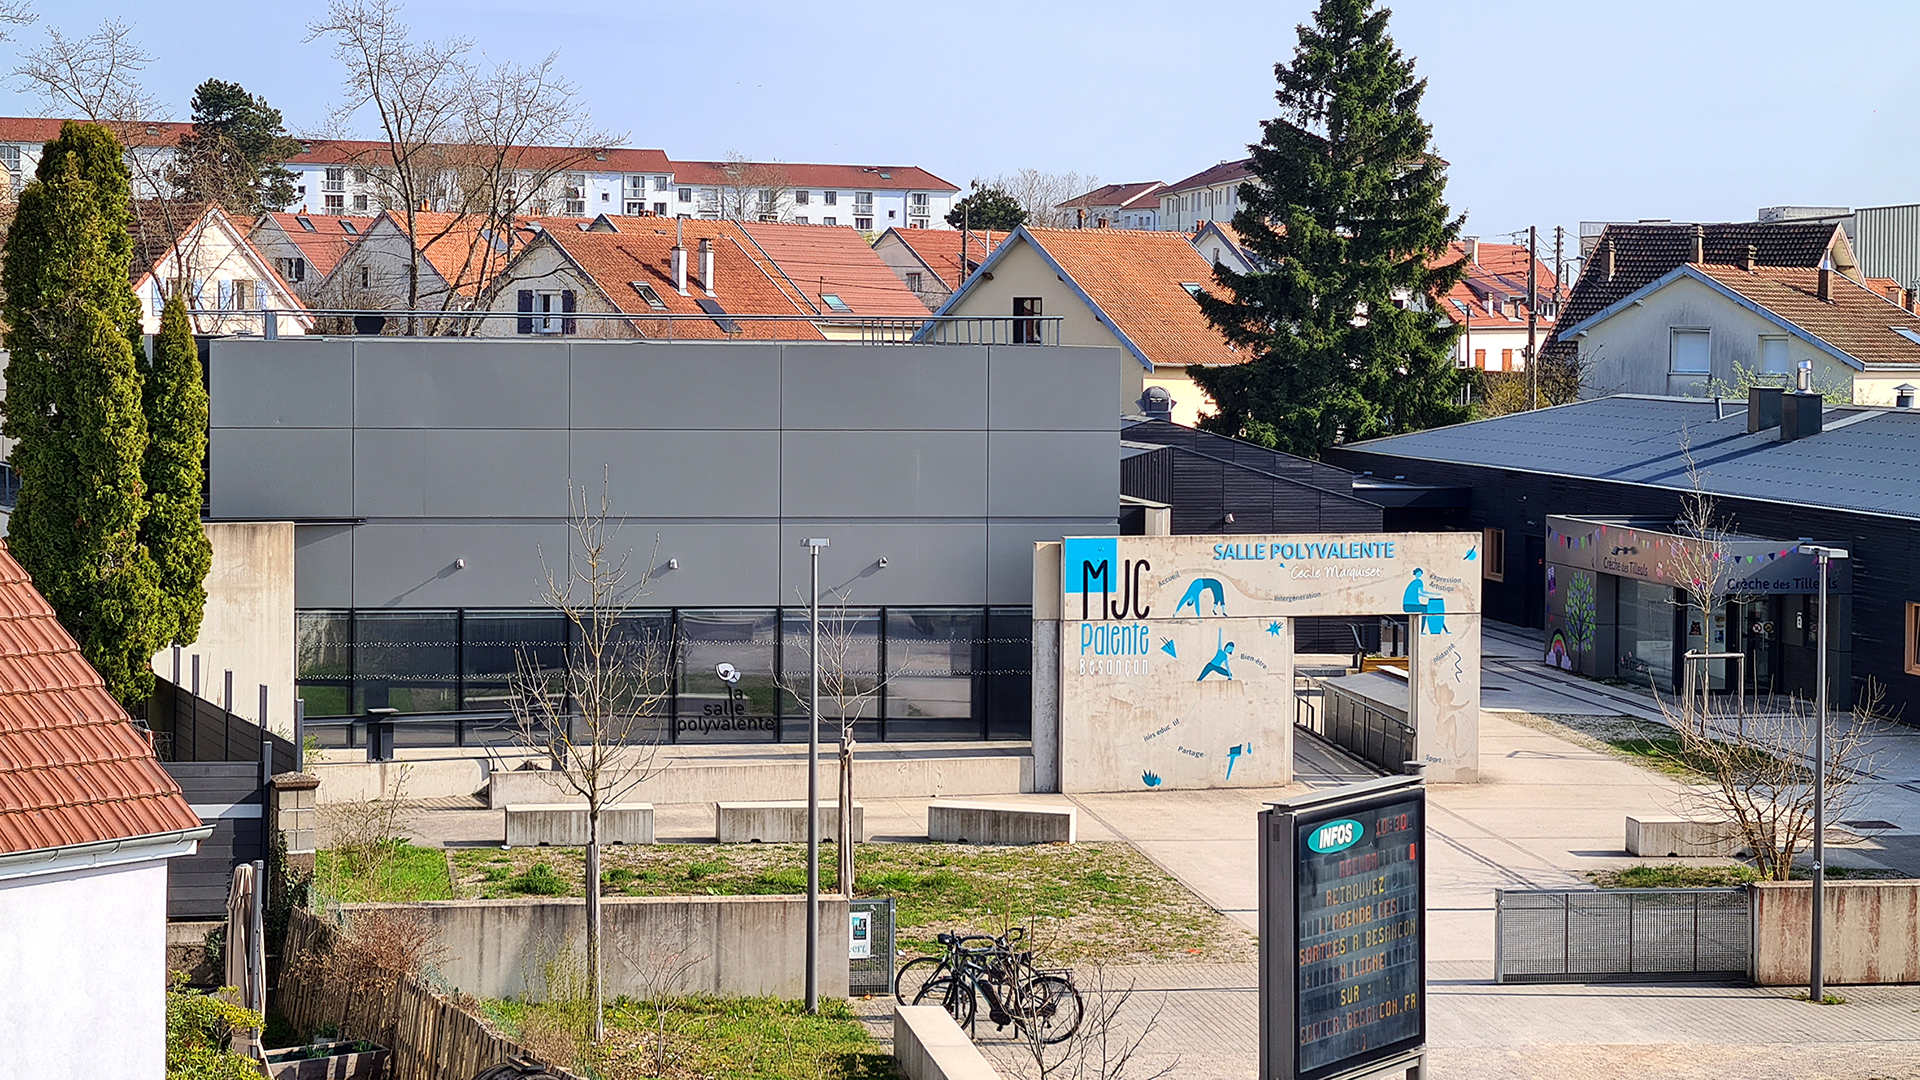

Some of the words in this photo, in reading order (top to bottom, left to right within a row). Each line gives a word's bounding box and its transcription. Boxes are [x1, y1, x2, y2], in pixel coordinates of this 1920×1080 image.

[1213, 542, 1266, 560] SALLE
[1270, 541, 1395, 560] POLYVALENTE
[1158, 571, 1181, 587] Accueil
[1323, 564, 1381, 582] Marquiset
[1727, 577, 1770, 590] Crèche
[1773, 579, 1791, 590] des
[1793, 578, 1838, 590] Tillels
[1082, 559, 1150, 620] MJC
[1081, 622, 1149, 655] Palente
[1080, 659, 1148, 677] Besançon
[727, 686, 743, 701] la
[703, 700, 745, 716] salle
[677, 716, 775, 735] polyvalente
[1178, 745, 1204, 758] Partage
[1376, 813, 1407, 836] 10:30
[1319, 822, 1353, 849] INFOS
[1339, 852, 1378, 878] AGENDA
[1326, 876, 1385, 907] RETROUVEZ
[1319, 905, 1372, 934] L'AGENDA
[1378, 898, 1397, 919] DES
[1299, 938, 1346, 966] SORTIES
[1353, 934, 1359, 951] A
[1366, 918, 1416, 947] BESANCON
[1353, 952, 1385, 977] LIGNE
[1341, 985, 1359, 1006] SUR
